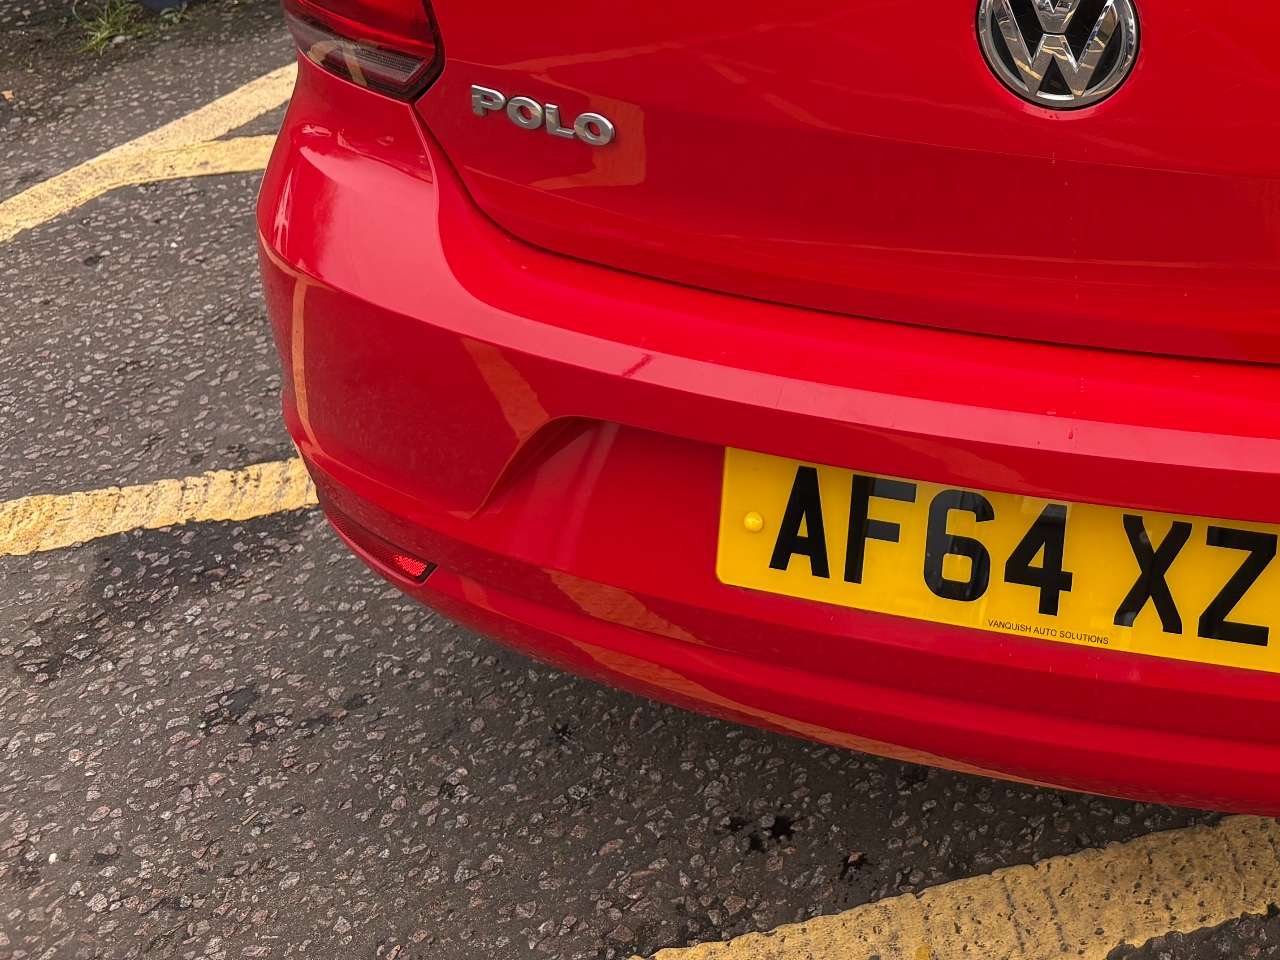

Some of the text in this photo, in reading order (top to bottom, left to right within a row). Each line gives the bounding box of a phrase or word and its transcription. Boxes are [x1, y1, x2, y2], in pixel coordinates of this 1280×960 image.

[471, 84, 616, 146] POLO
[769, 465, 1073, 616] AF64
[1033, 626, 1058, 637] AUTO
[1059, 630, 1109, 645] SOLUTIONS
